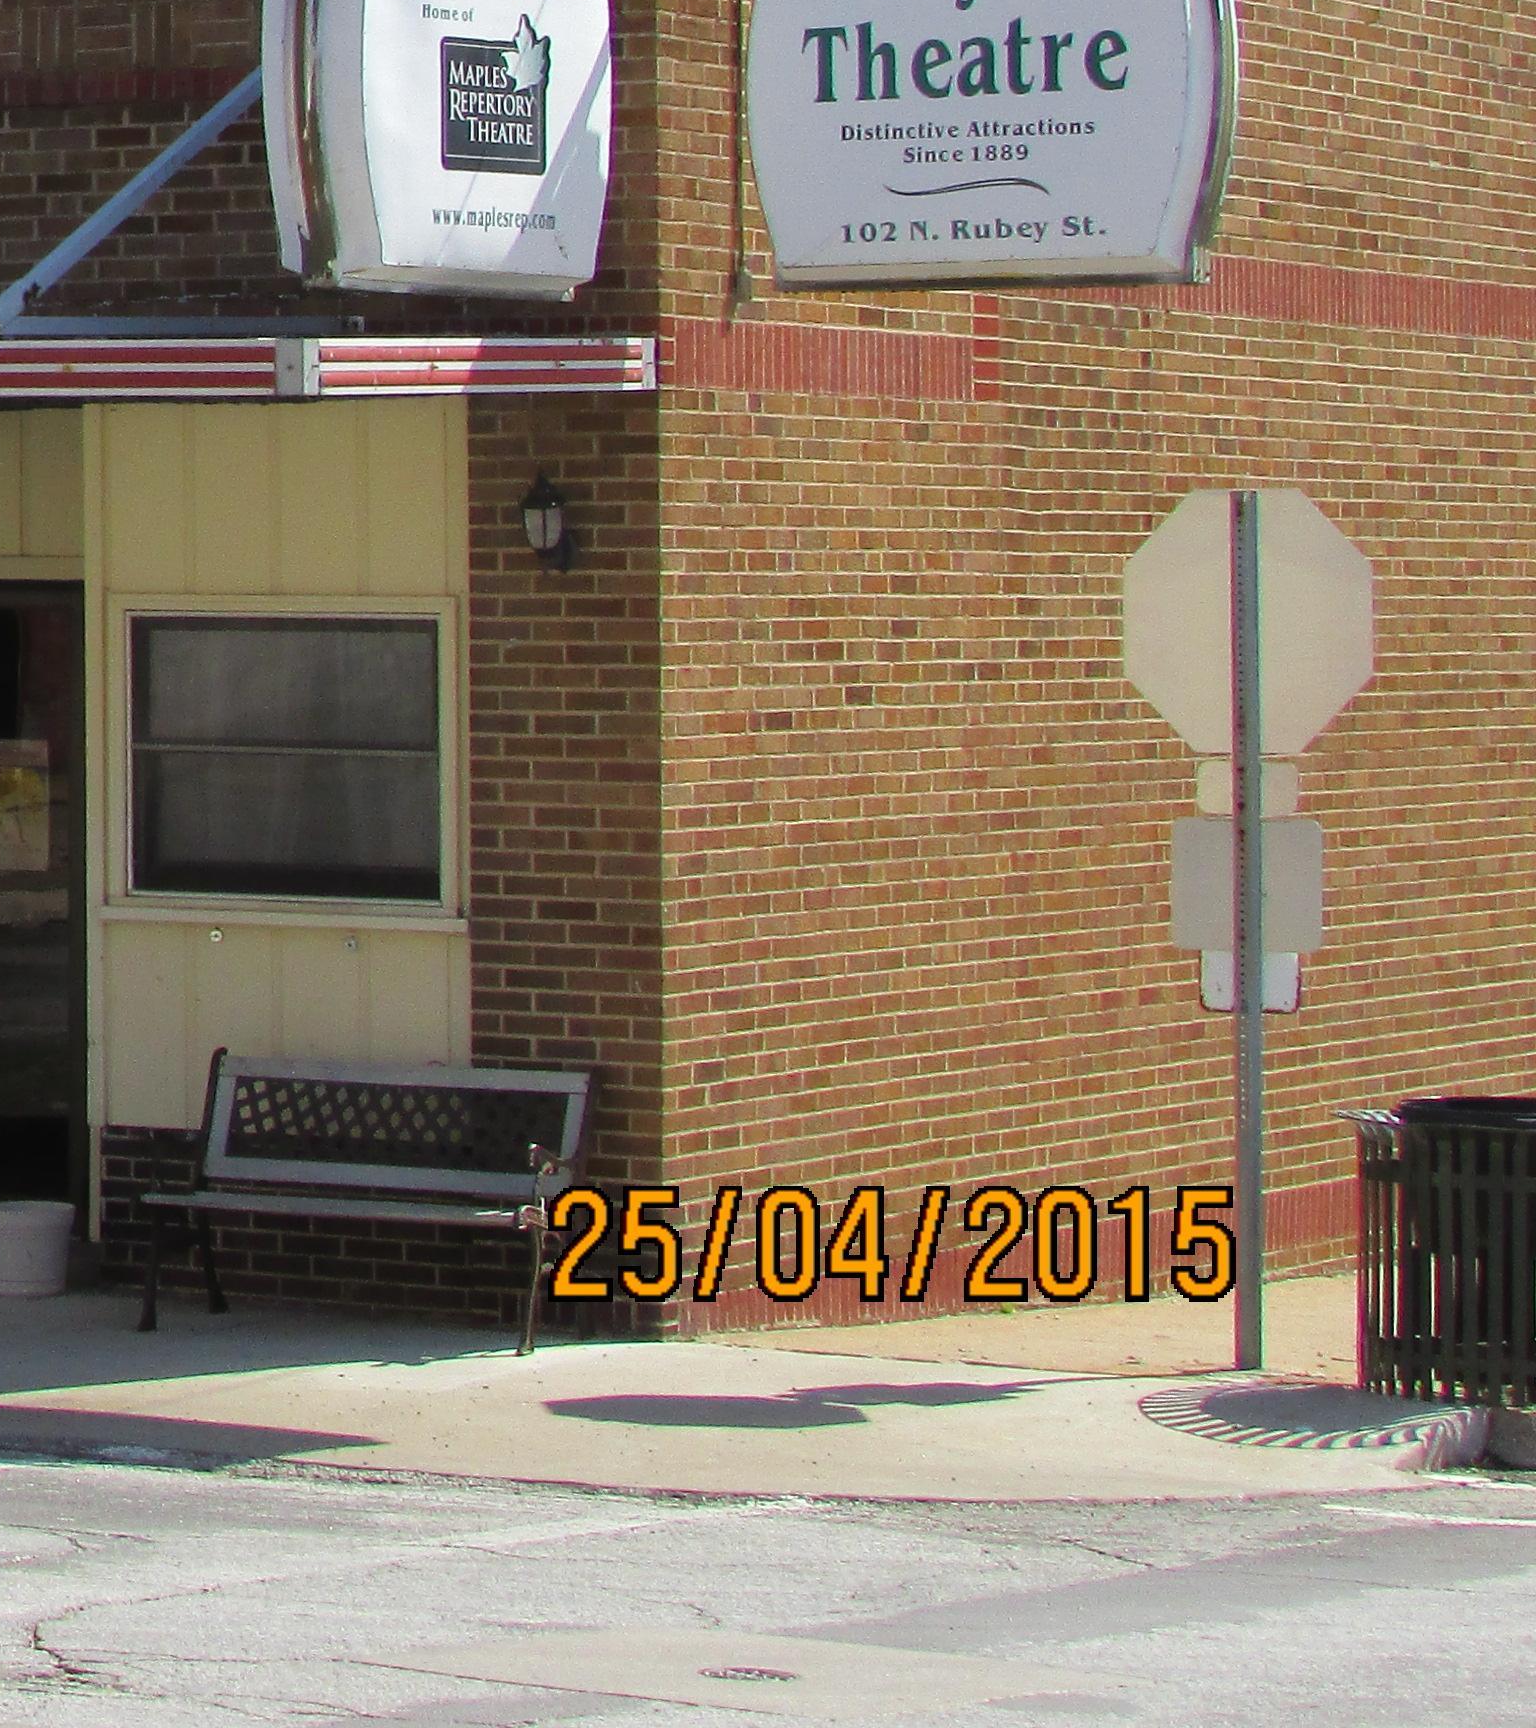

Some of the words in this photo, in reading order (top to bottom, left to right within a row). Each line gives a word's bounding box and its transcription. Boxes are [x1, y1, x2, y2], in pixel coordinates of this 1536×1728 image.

[422, 4, 459, 21] Home
[461, 8, 473, 22] of
[802, 18, 1129, 103] Theatre
[449, 61, 507, 89] MAPLES
[450, 90, 534, 120] REPERTORY
[467, 117, 533, 145] THEATRE
[841, 122, 959, 141] Distinctive
[967, 119, 1095, 137] Attractions
[903, 146, 963, 163] Since
[971, 144, 1030, 162] 1889
[432, 206, 556, 231] www.maplesrep.com
[842, 222, 897, 242] 102
[910, 221, 939, 241] N.
[951, 218, 1048, 242] Rubey
[1062, 216, 1107, 237] St.
